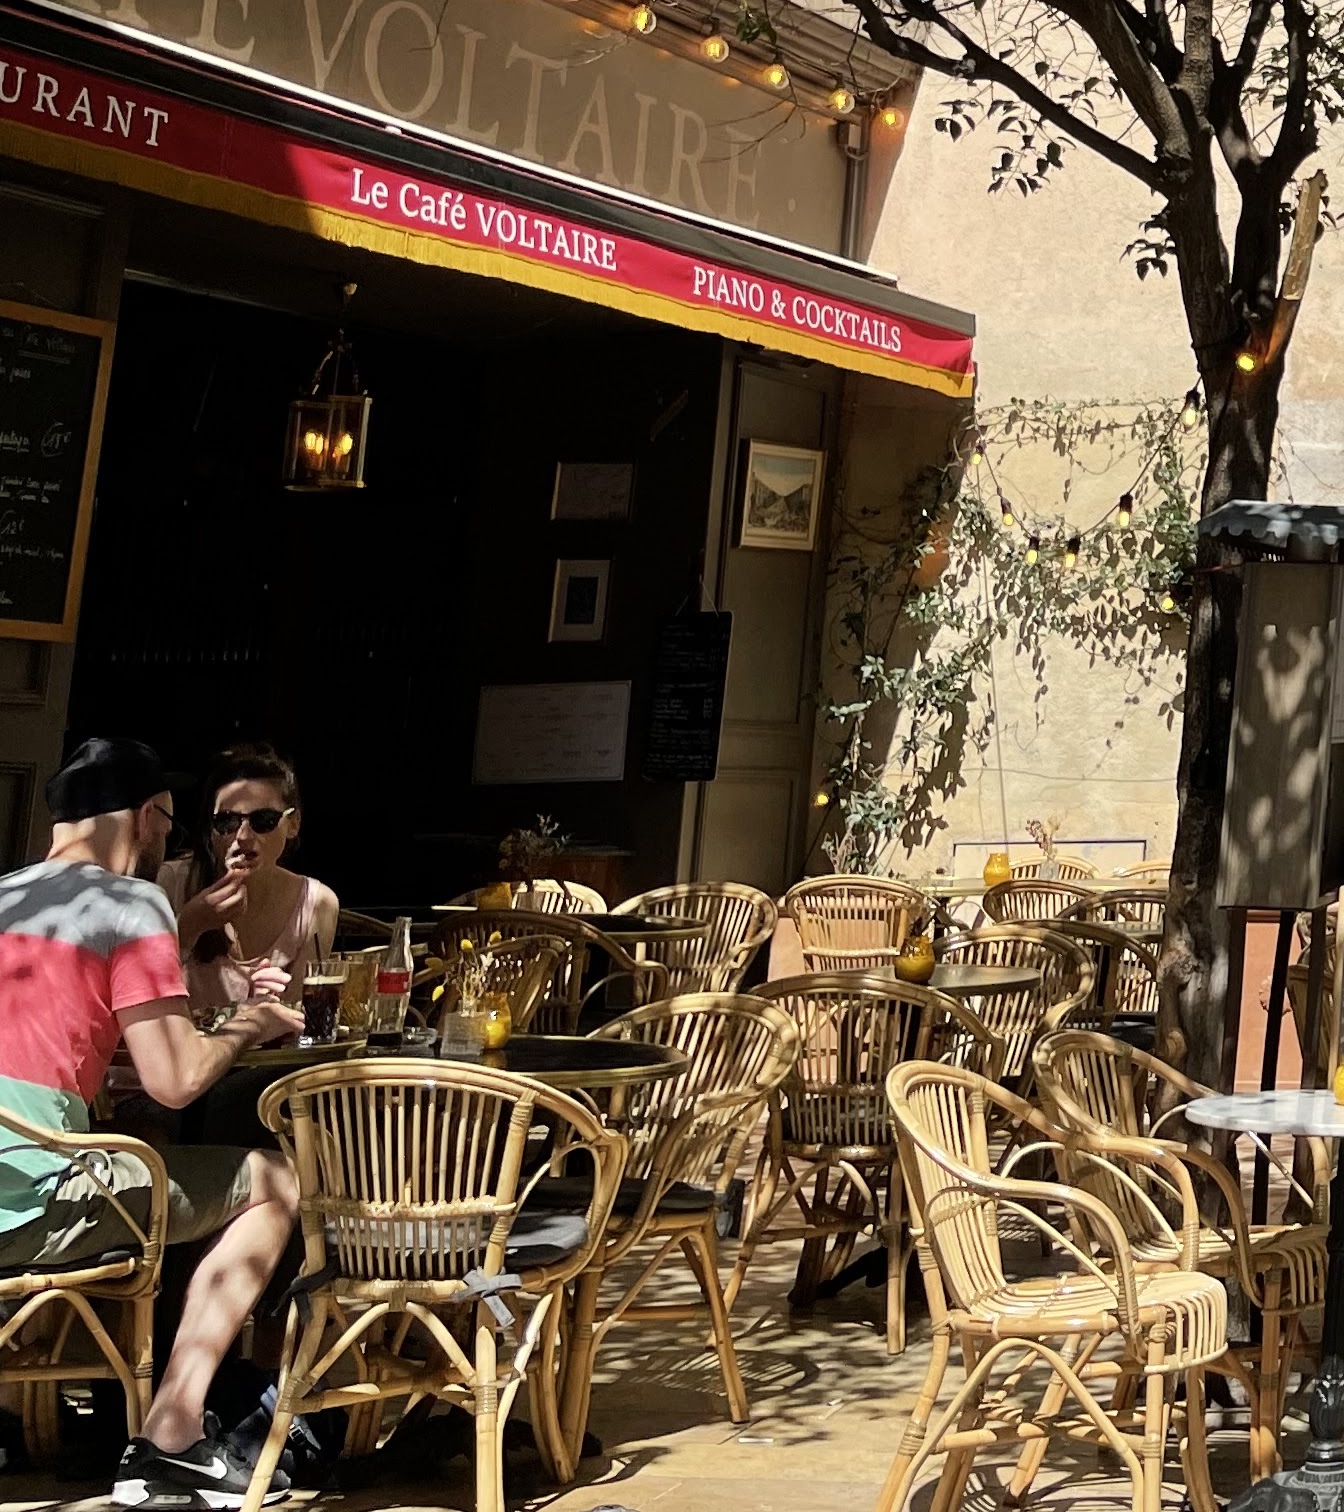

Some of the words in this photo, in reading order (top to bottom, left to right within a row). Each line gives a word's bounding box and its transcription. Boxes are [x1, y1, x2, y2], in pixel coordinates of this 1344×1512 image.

[351, 167, 389, 209] Le
[399, 183, 467, 230] Café
[476, 201, 618, 271] VOLTAIRE
[693, 266, 765, 312] PIANO
[771, 289, 787, 319] &
[792, 295, 901, 353] COCKTAILS
